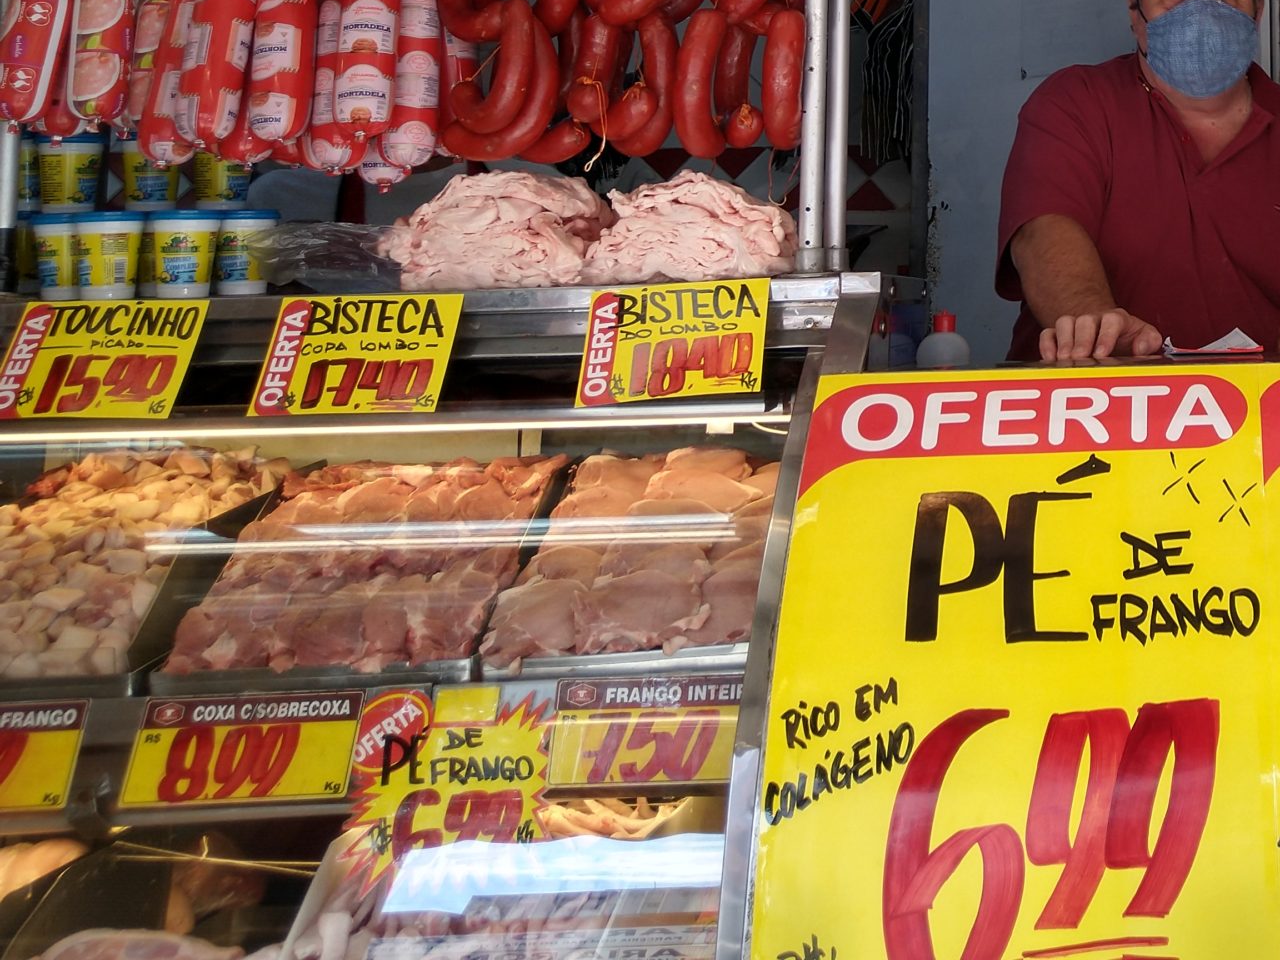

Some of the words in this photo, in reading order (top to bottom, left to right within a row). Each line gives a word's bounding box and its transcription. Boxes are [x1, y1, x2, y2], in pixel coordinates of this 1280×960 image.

[49, 300, 200, 339] TOUCINHO
[300, 296, 443, 339] BISTECA
[608, 284, 760, 329] BISTECA
[91, 338, 144, 350] PICADO
[301, 342, 348, 356] COPA
[360, 339, 419, 352] LOMBO
[584, 301, 618, 398] OFERTA
[620, 328, 652, 341] DO
[660, 322, 737, 334] LOMBO
[0, 314, 51, 409] OFERTA
[259, 310, 308, 407] OFERTA
[841, 383, 1233, 451] OFERTA
[904, 454, 1112, 643] PÉ
[1120, 530, 1193, 580] DE
[1090, 586, 1260, 646] FRANGO
[193, 703, 235, 721] COXA
[240, 699, 350, 720] C/SOBRECOXA
[606, 685, 682, 704] FRANGO
[780, 700, 840, 750] RICO
[854, 676, 898, 723] EM
[0, 708, 77, 729] FRANGO
[354, 703, 423, 762] OFERTA
[442, 728, 483, 751] DE
[324, 781, 341, 793] Kg
[430, 756, 534, 785] FRANGO
[765, 722, 915, 826] COLÁGENO
